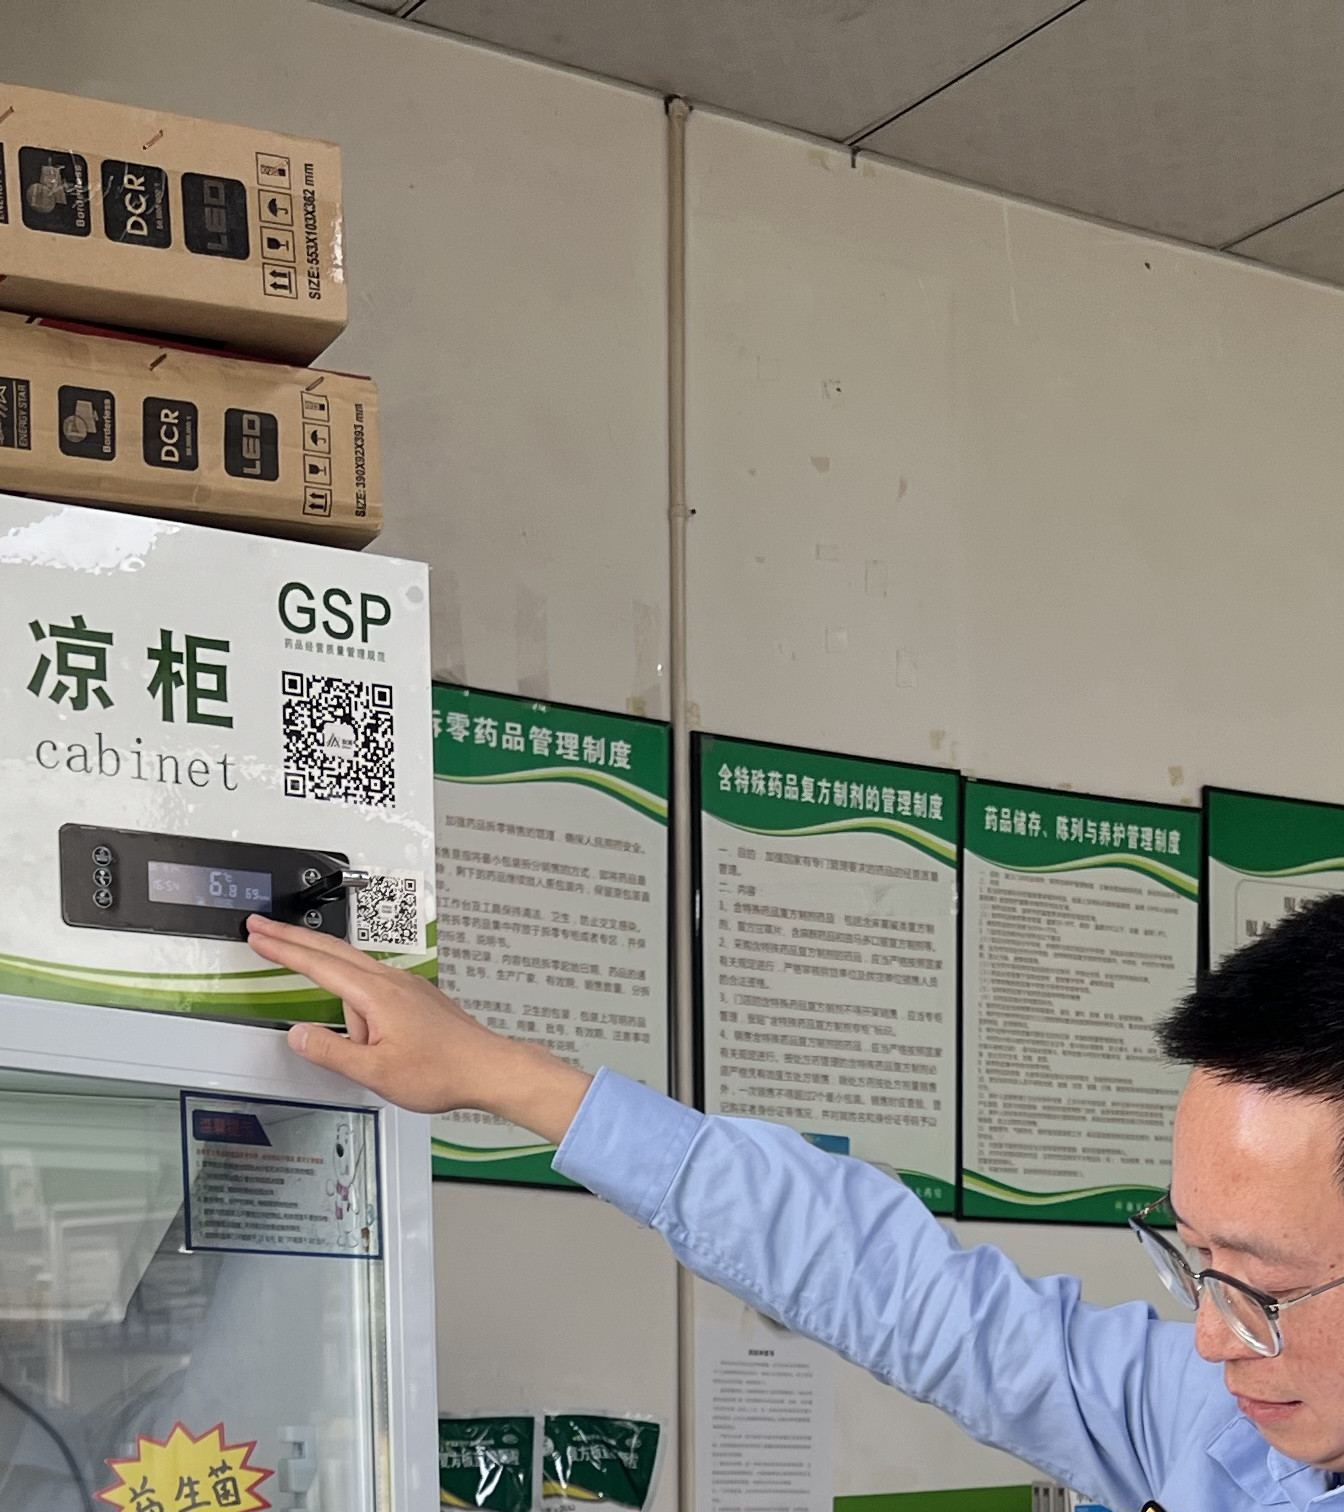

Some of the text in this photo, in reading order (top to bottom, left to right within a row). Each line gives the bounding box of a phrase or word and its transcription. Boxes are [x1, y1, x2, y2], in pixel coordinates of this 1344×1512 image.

[123, 173, 149, 237] DCR
[203, 178, 229, 250] LED
[16, 383, 27, 414] STAR
[160, 407, 181, 463] DCR
[241, 413, 262, 476] LED
[278, 581, 393, 645] GSP
[283, 636, 388, 664] 药品经营质量管理规范
[35, 732, 240, 792] cabinet
[717, 762, 944, 821] 含特殊药品复方制剂的管理制度
[983, 804, 1182, 856] 药品储存、陈列与养护管理制度
